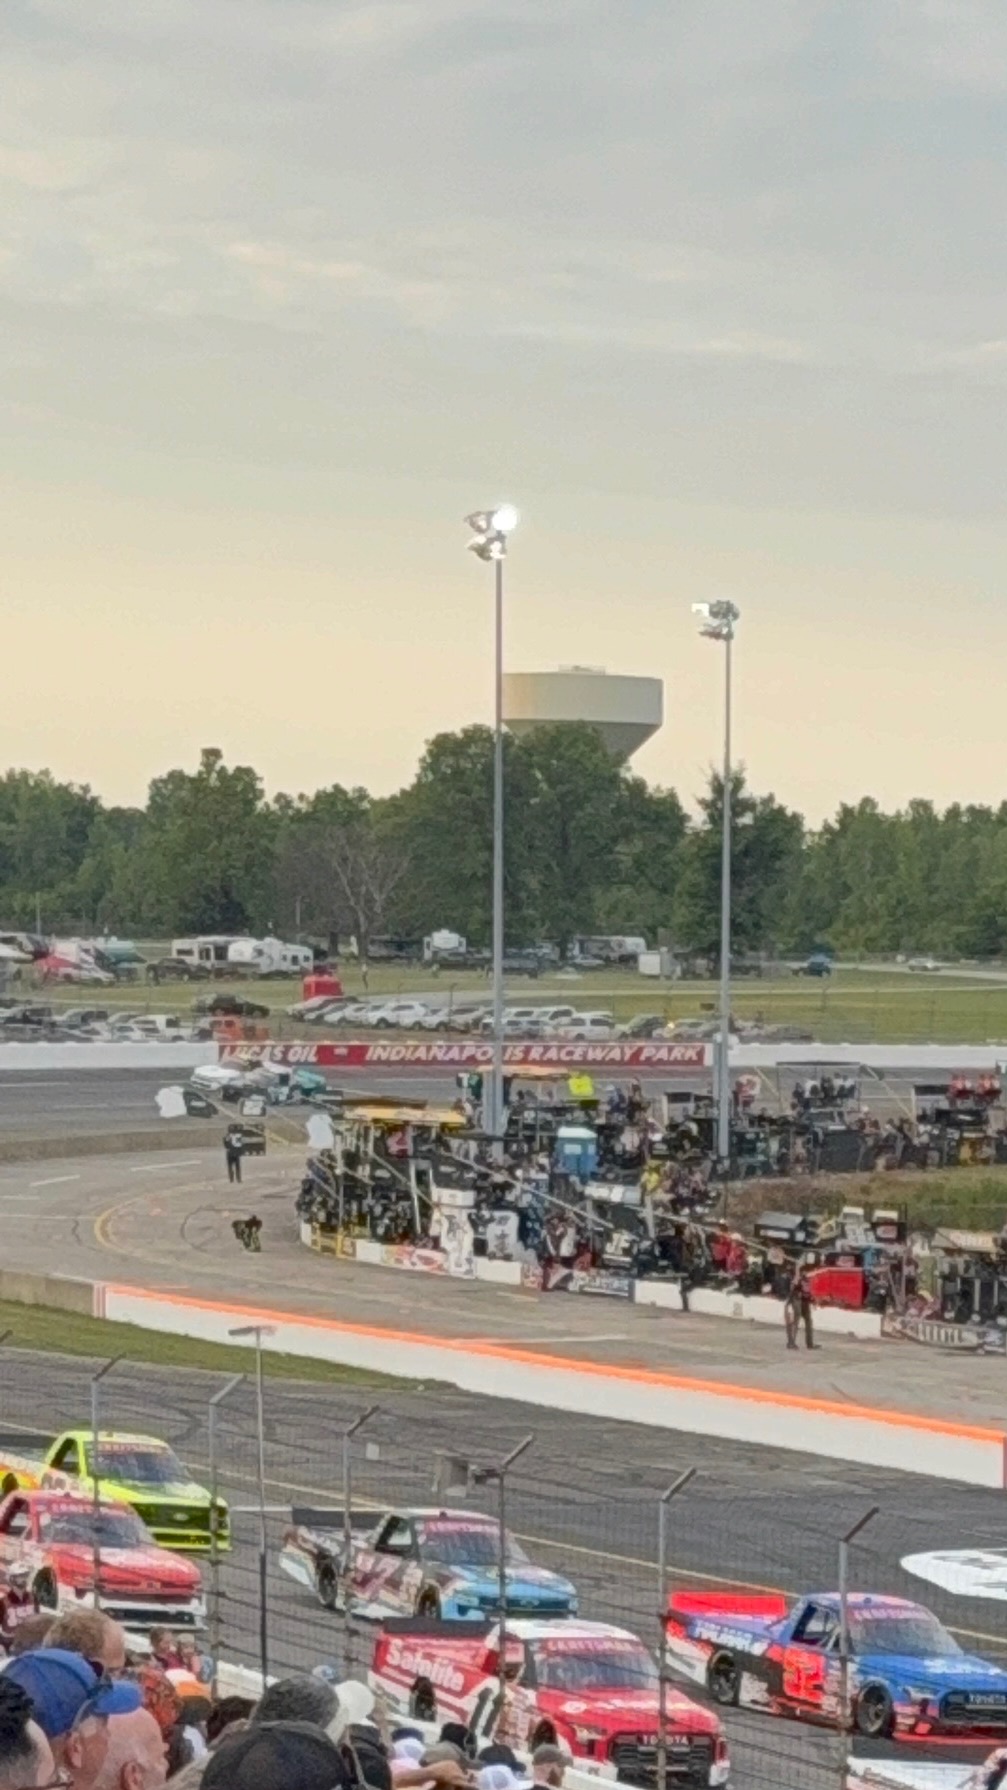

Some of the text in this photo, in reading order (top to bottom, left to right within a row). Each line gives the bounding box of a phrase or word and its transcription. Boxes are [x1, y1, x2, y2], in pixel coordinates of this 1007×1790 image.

[287, 1045, 320, 1063] OIL
[365, 1044, 525, 1062] INDIANAPOIS
[528, 1045, 638, 1062] RACEWAY
[639, 1045, 700, 1062] PARK
[641, 1734, 689, 1745] TOOTA
